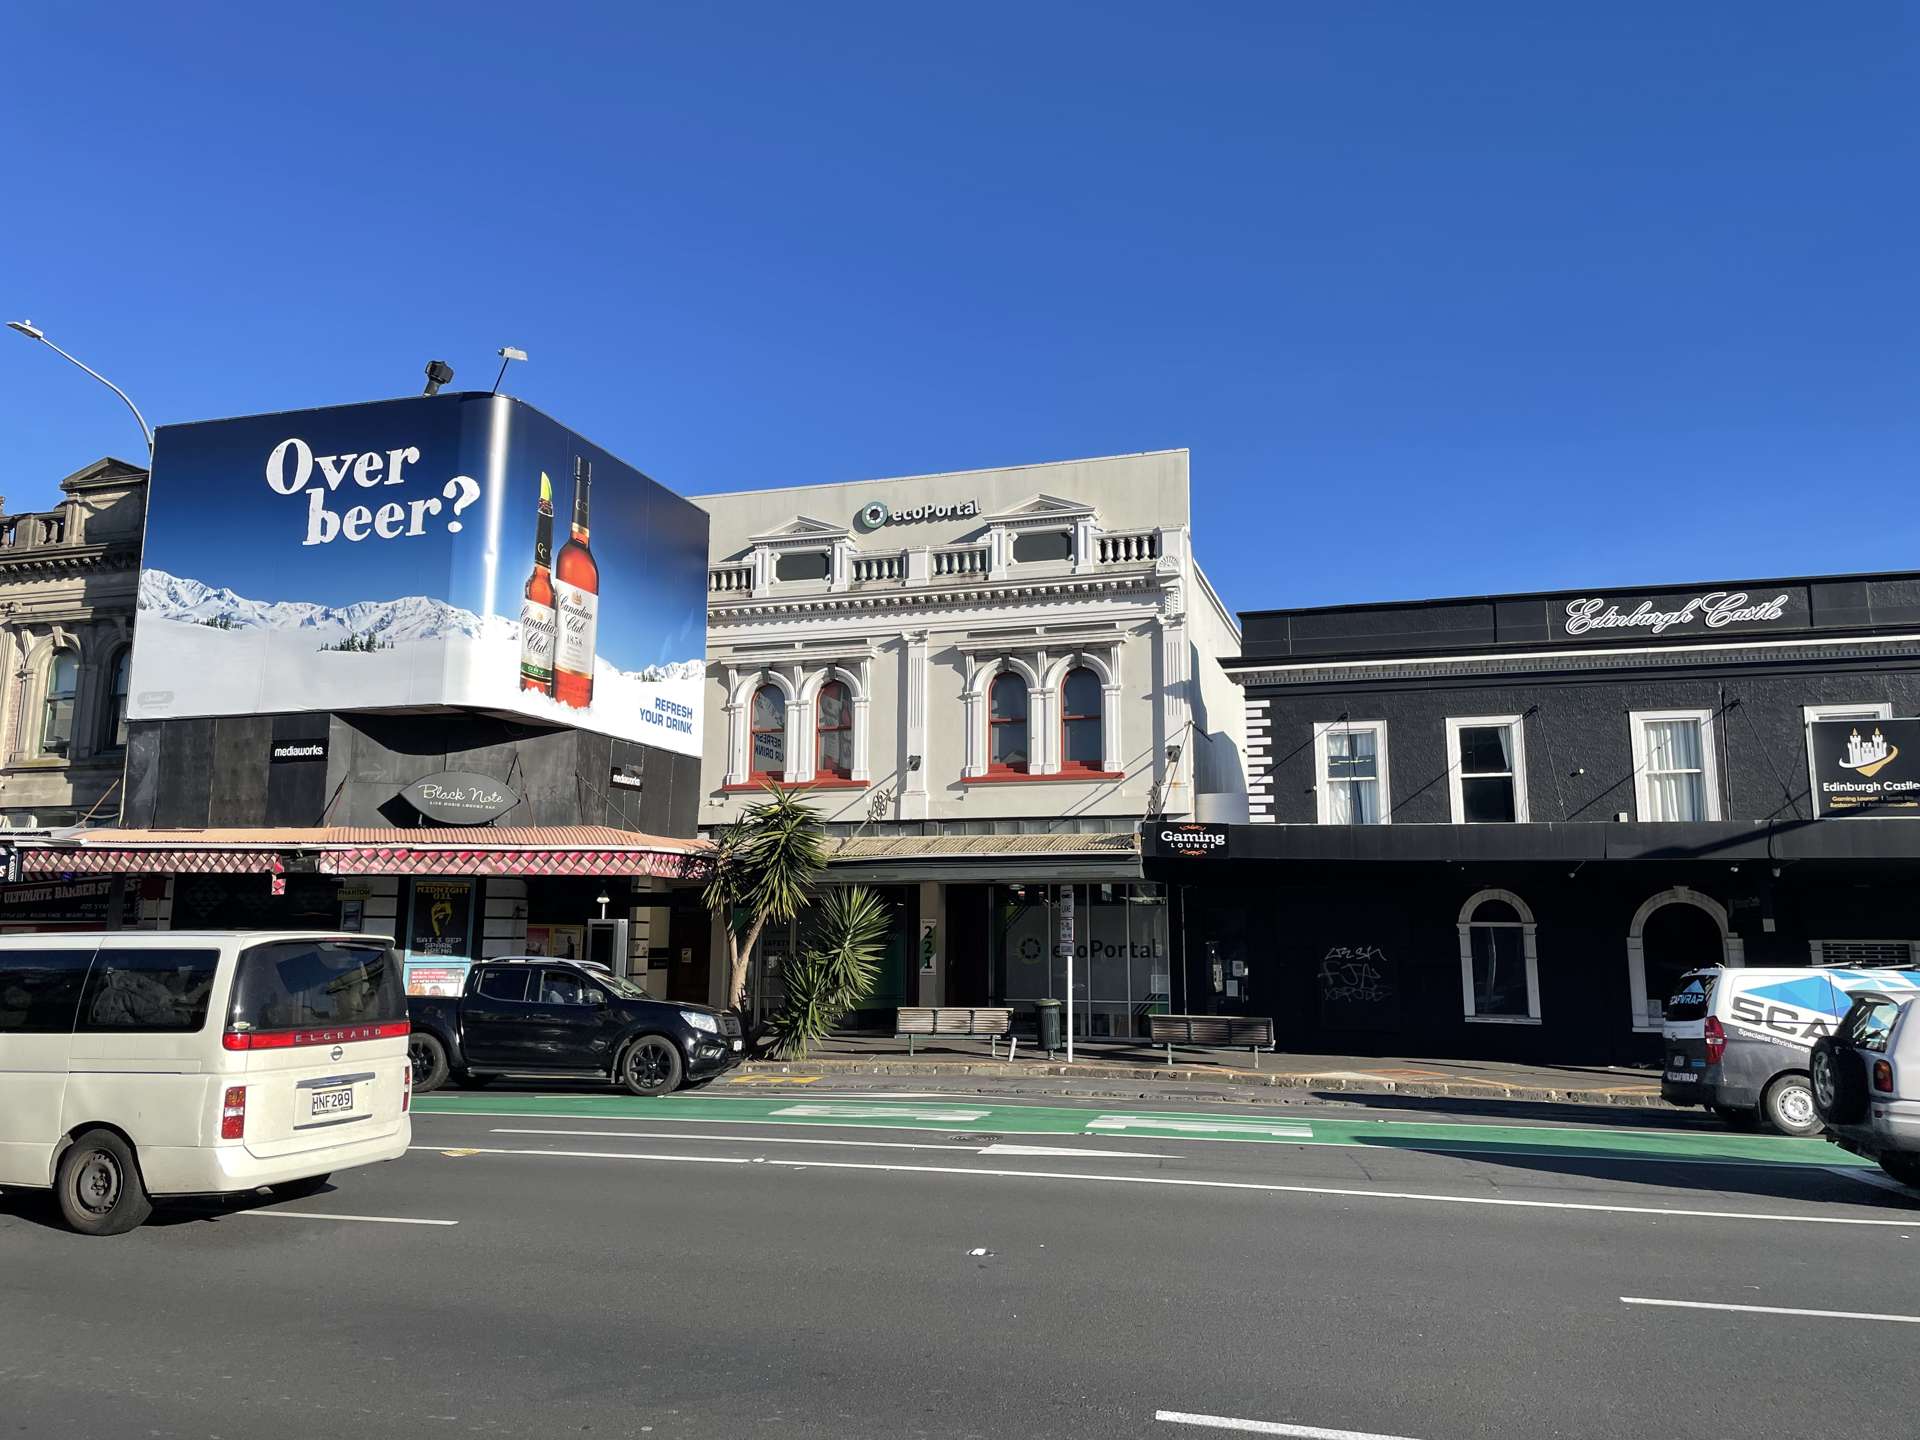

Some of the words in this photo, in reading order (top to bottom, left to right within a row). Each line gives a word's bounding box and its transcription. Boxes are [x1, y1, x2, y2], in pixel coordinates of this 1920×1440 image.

[266, 437, 420, 496] Over
[302, 475, 481, 546] beer?
[892, 496, 981, 521] ecoPortal
[560, 592, 593, 620] Canadian
[1565, 598, 1701, 635] Edinburgh
[1700, 592, 1789, 628] Castle
[520, 605, 557, 638] Canadian
[565, 613, 584, 635] Club
[526, 630, 548, 655] Club
[656, 697, 693, 719] REFRESH
[640, 708, 668, 727] YOUR
[666, 716, 692, 734] DRINK
[274, 745, 323, 757] mediaworks
[417, 784, 465, 801] Black
[468, 787, 504, 803] Note
[1823, 782, 1881, 794] Edinburgh
[1161, 831, 1225, 845] Gaming
[4, 888, 52, 904] ULTIMATE
[416, 886, 470, 894] MIDNIGHT
[296, 1029, 381, 1042] ELGRAND
[1738, 1028, 1771, 1043] Specialist
[1772, 1037, 1810, 1053] Shrinkwrap
[313, 1093, 350, 1110] HNF209
